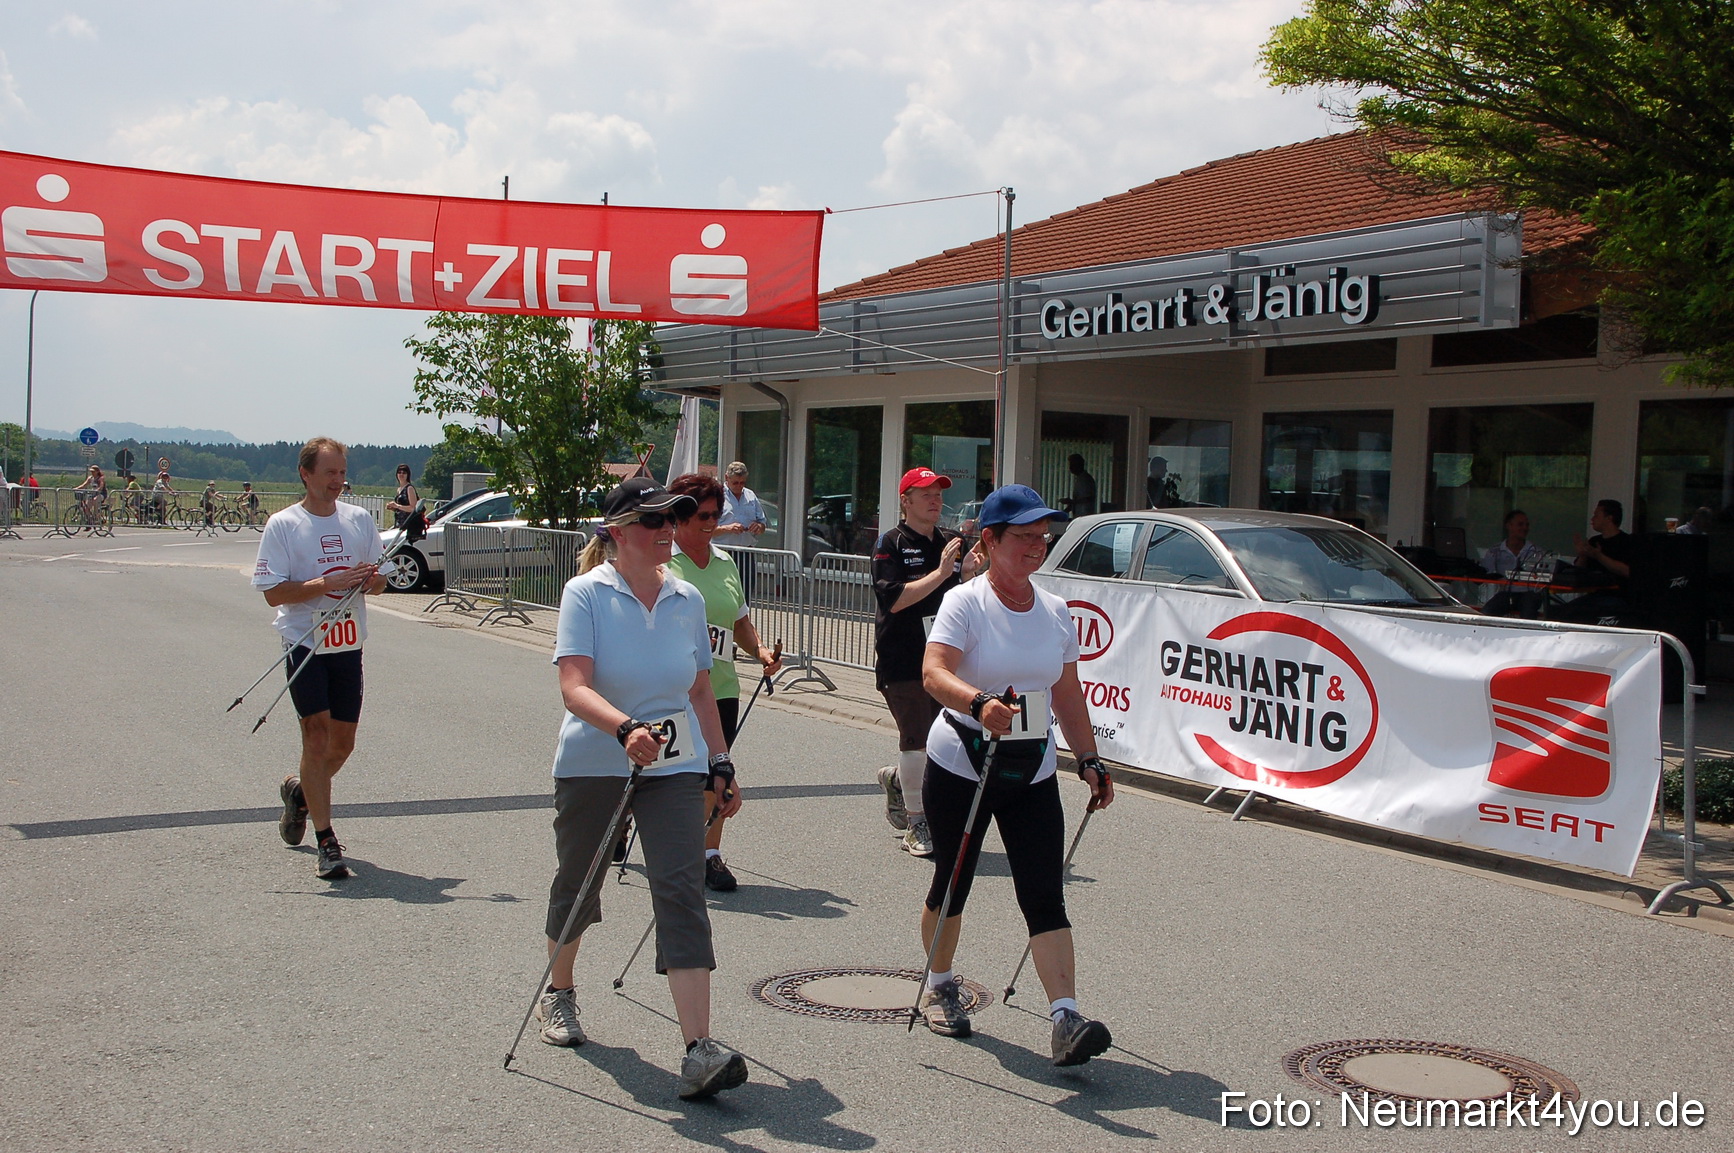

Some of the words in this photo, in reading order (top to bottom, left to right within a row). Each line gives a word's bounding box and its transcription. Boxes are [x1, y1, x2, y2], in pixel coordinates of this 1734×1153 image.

[1040, 288, 1190, 340] Gerhart
[1202, 283, 1234, 326] &
[1245, 264, 1379, 326] Jänig
[317, 555, 352, 564] SEAT
[321, 619, 357, 648] 100
[1072, 616, 1102, 649] IA
[1160, 640, 1324, 704] GERHART
[1326, 675, 1346, 702] &
[1082, 681, 1131, 712] TORS
[1160, 683, 1232, 711] AUTOHAUS
[1228, 695, 1347, 752] JÄNIG
[1478, 802, 1615, 843] SEAT
